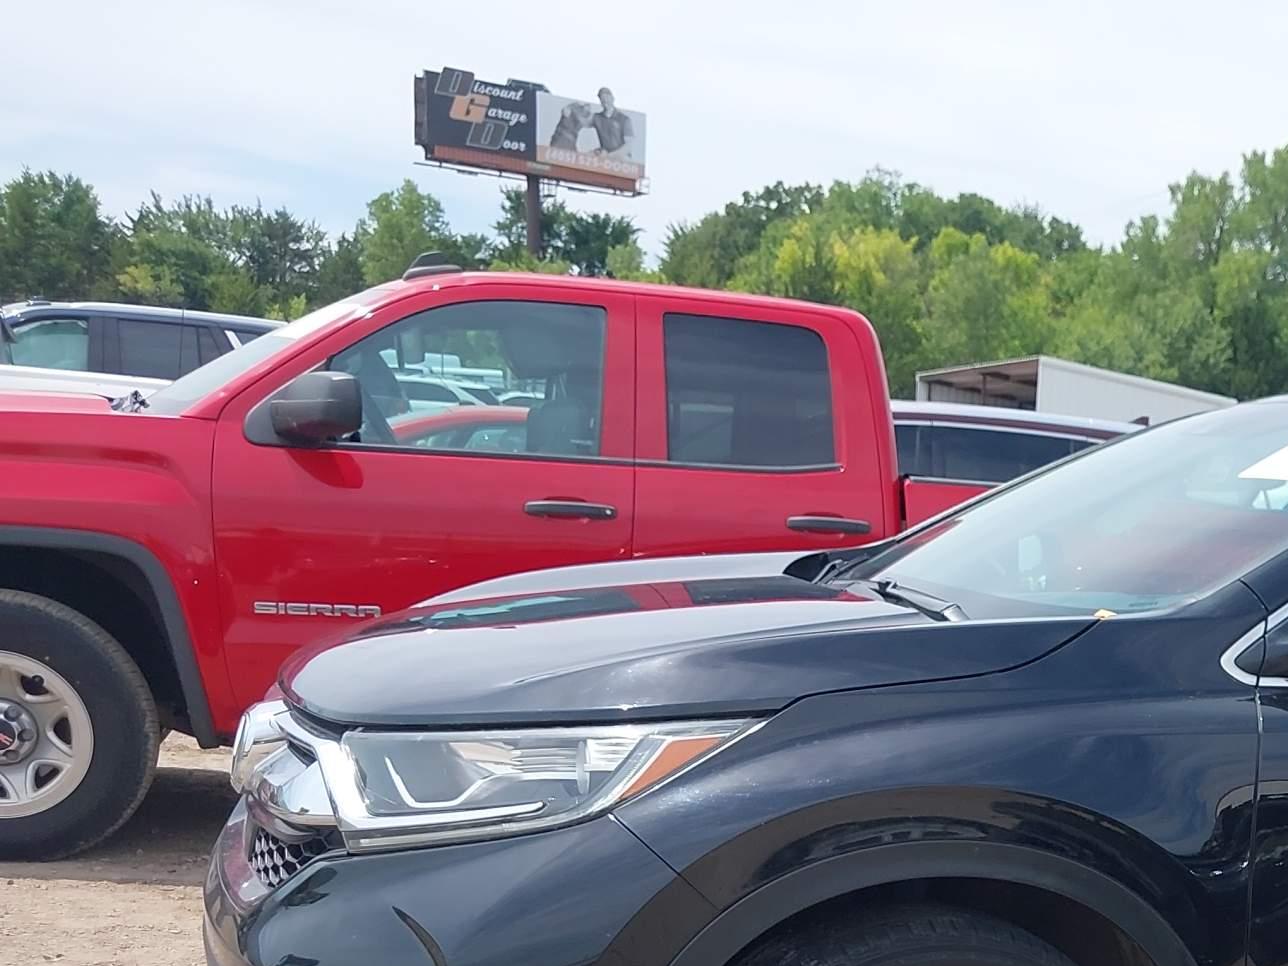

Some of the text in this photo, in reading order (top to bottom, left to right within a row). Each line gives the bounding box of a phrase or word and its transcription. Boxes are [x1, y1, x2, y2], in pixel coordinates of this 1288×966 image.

[434, 66, 524, 101] Discount
[449, 94, 528, 126] Garage
[254, 601, 381, 618] SIERRA
